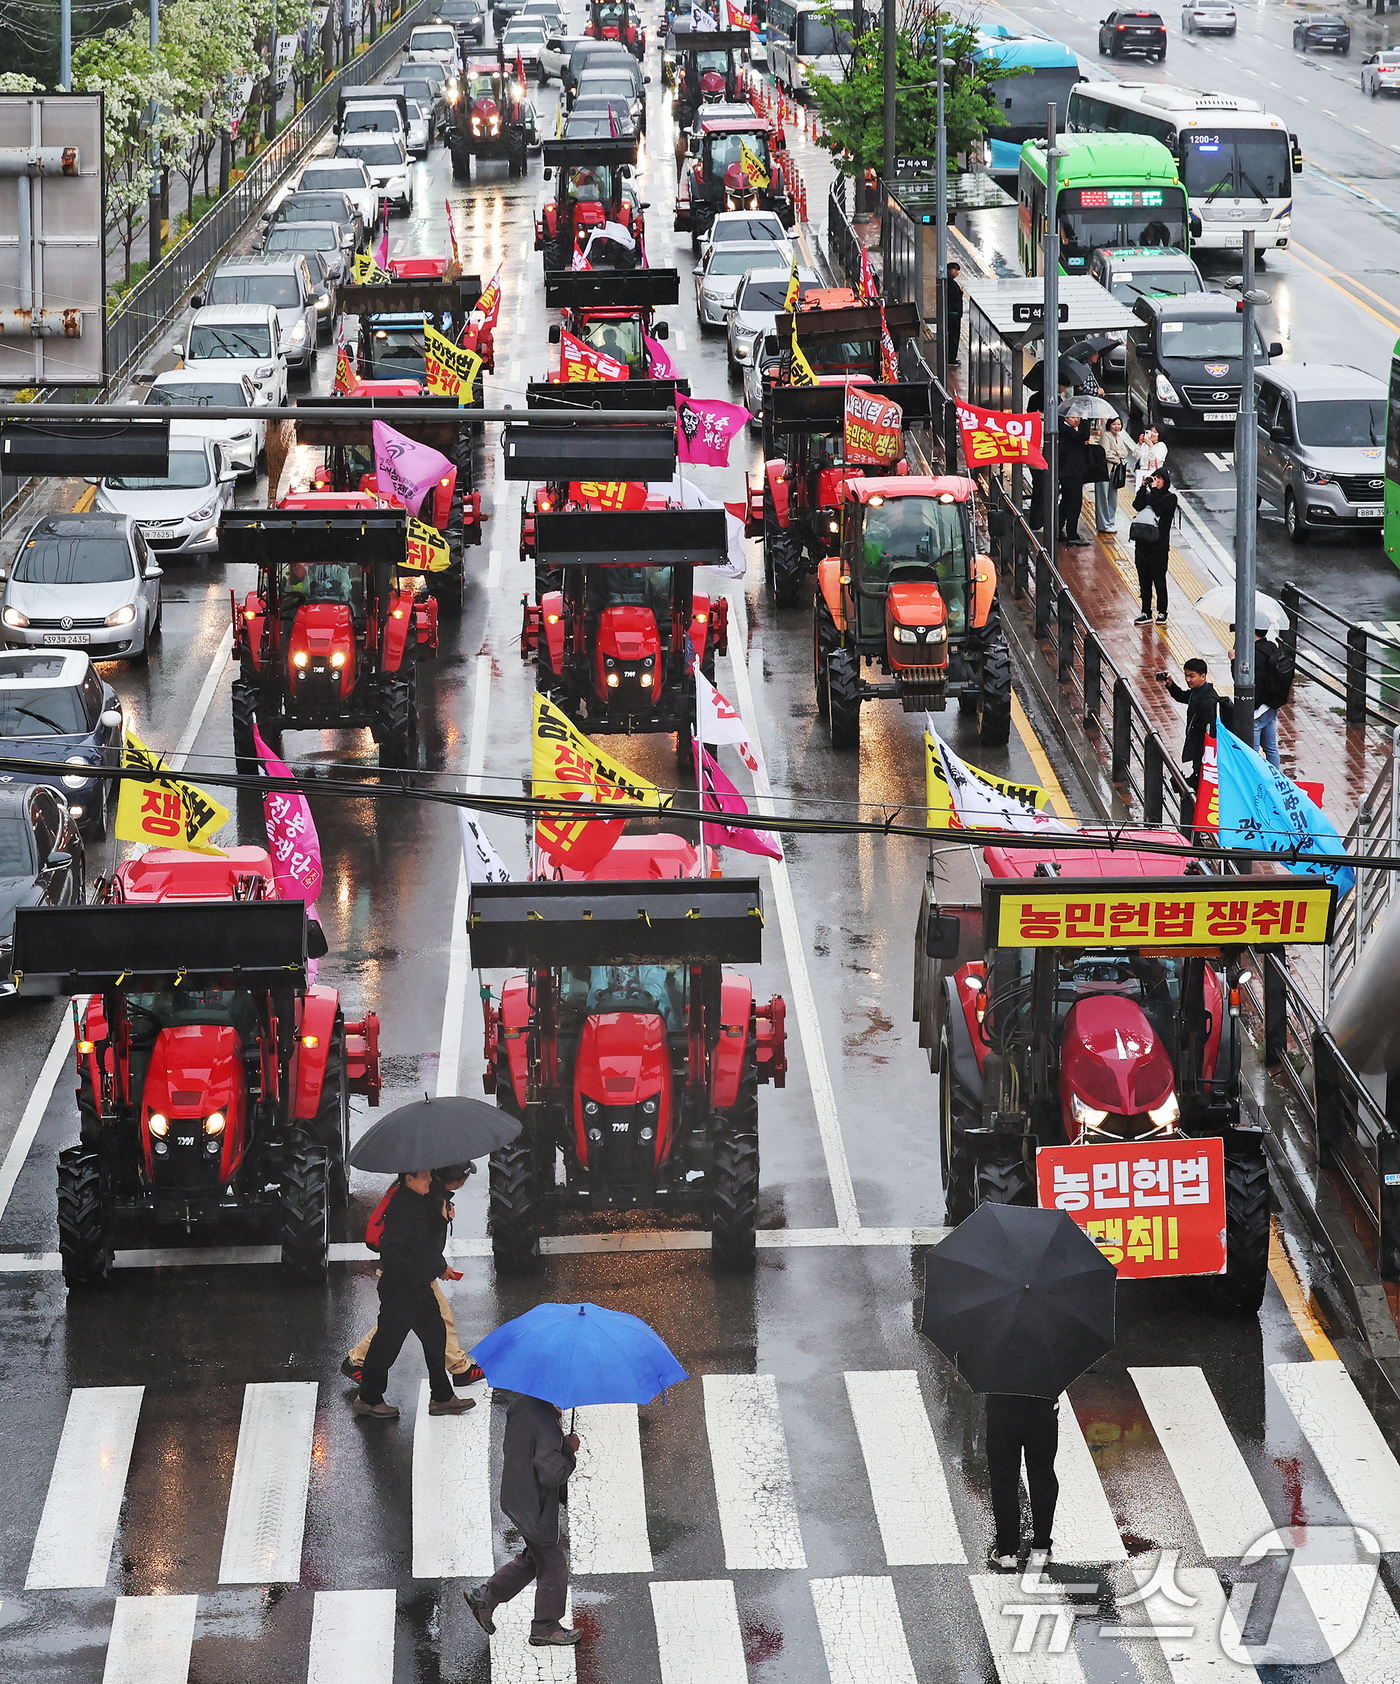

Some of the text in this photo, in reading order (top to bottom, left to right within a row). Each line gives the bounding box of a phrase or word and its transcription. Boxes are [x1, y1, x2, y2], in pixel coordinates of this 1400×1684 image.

[1189, 135, 1220, 144] 1200-2
[906, 159, 928, 168] 석수역
[970, 430, 1029, 460] 중단!
[152, 530, 171, 538] 7625
[67, 635, 88, 643] 2435
[1019, 899, 1308, 939] 농민헌법 쟁취!
[611, 1123, 630, 1132] TYM
[177, 1136, 195, 1146] TYM
[1053, 1156, 1210, 1212] 농민헌법
[1085, 1215, 1179, 1266] 쟁취!
